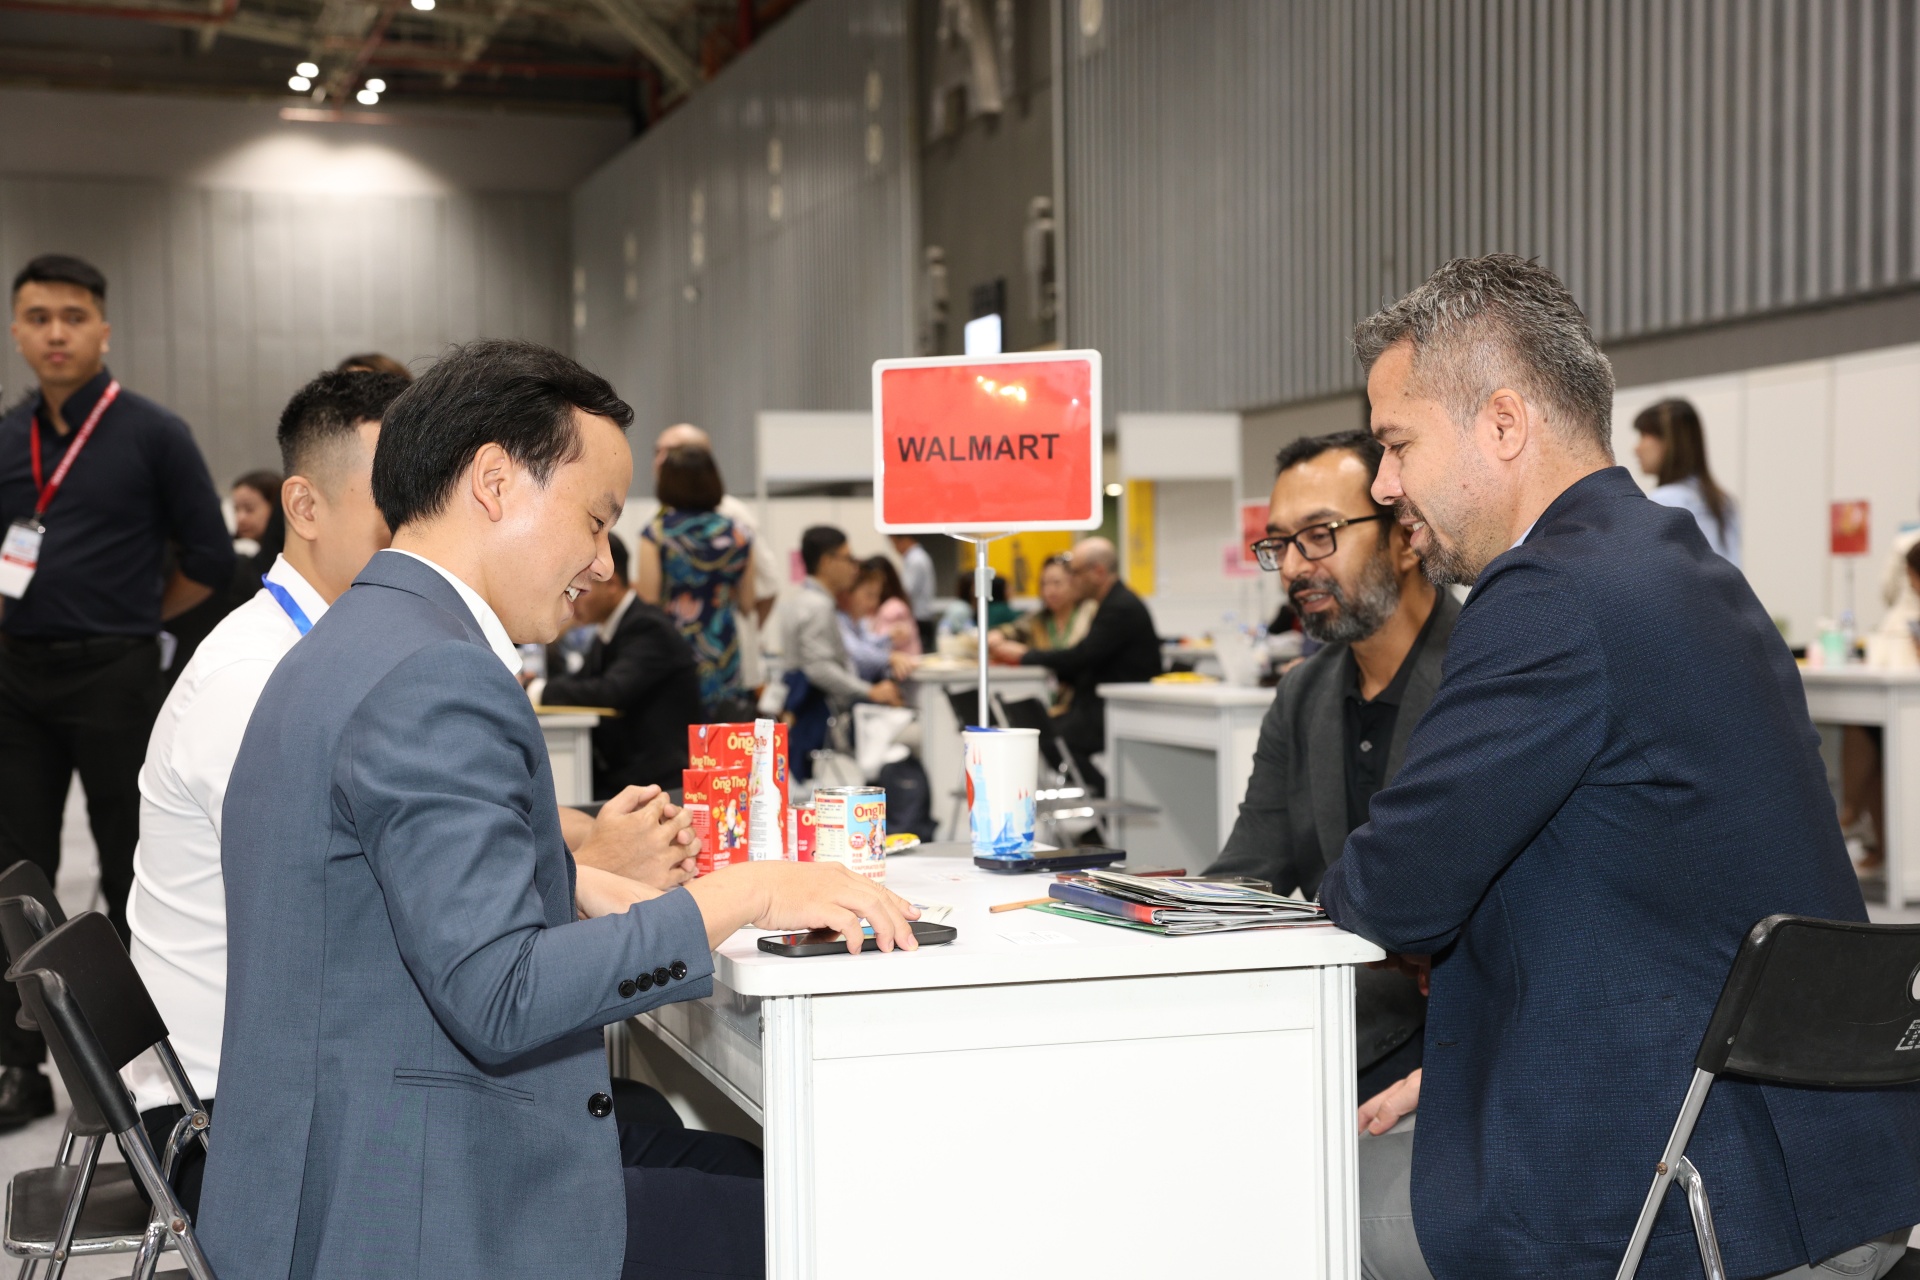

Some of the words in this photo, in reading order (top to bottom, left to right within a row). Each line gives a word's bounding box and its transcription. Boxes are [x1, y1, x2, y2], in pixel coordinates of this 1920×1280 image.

[897, 433, 1060, 462] WALMART
[712, 777, 732, 794] Ông
[854, 803, 877, 820] Ông
